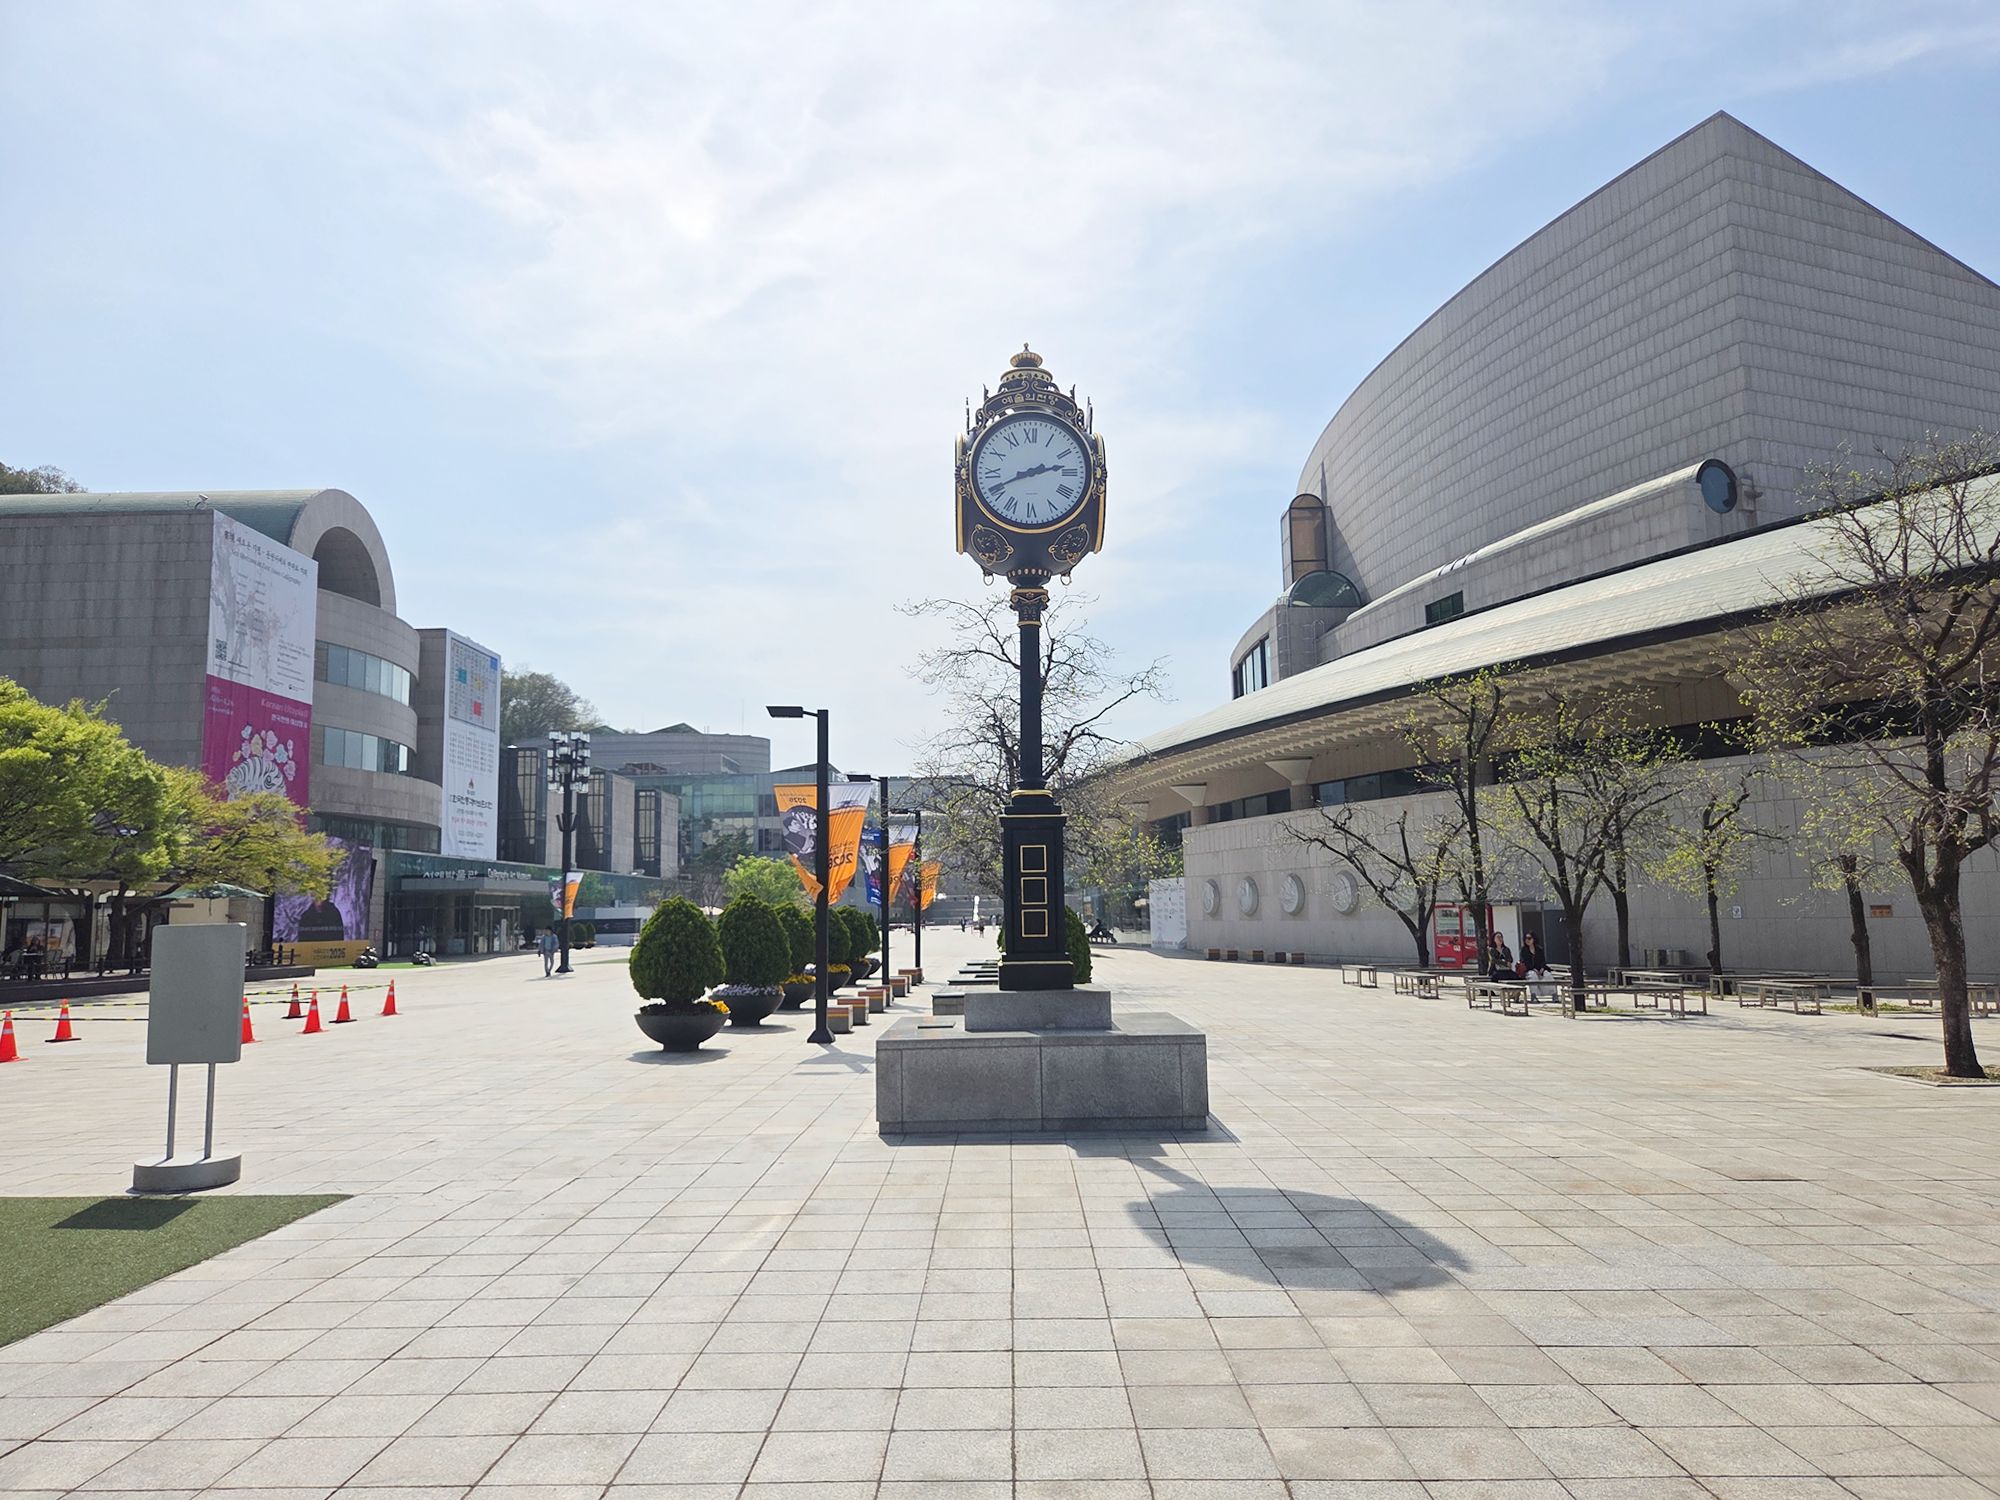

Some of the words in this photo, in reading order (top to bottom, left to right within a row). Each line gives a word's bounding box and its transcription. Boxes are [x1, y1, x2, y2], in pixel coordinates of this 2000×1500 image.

[1003, 431, 1020, 450] XI
[1023, 427, 1038, 444] XII
[1045, 433, 1055, 448] I
[989, 447, 1006, 462] X
[1056, 448, 1072, 460] II
[984, 467, 1001, 479] IX
[1061, 468, 1078, 477] III
[1003, 496, 1018, 515] VII
[1026, 502, 1037, 518] VI
[1046, 498, 1059, 513] V
